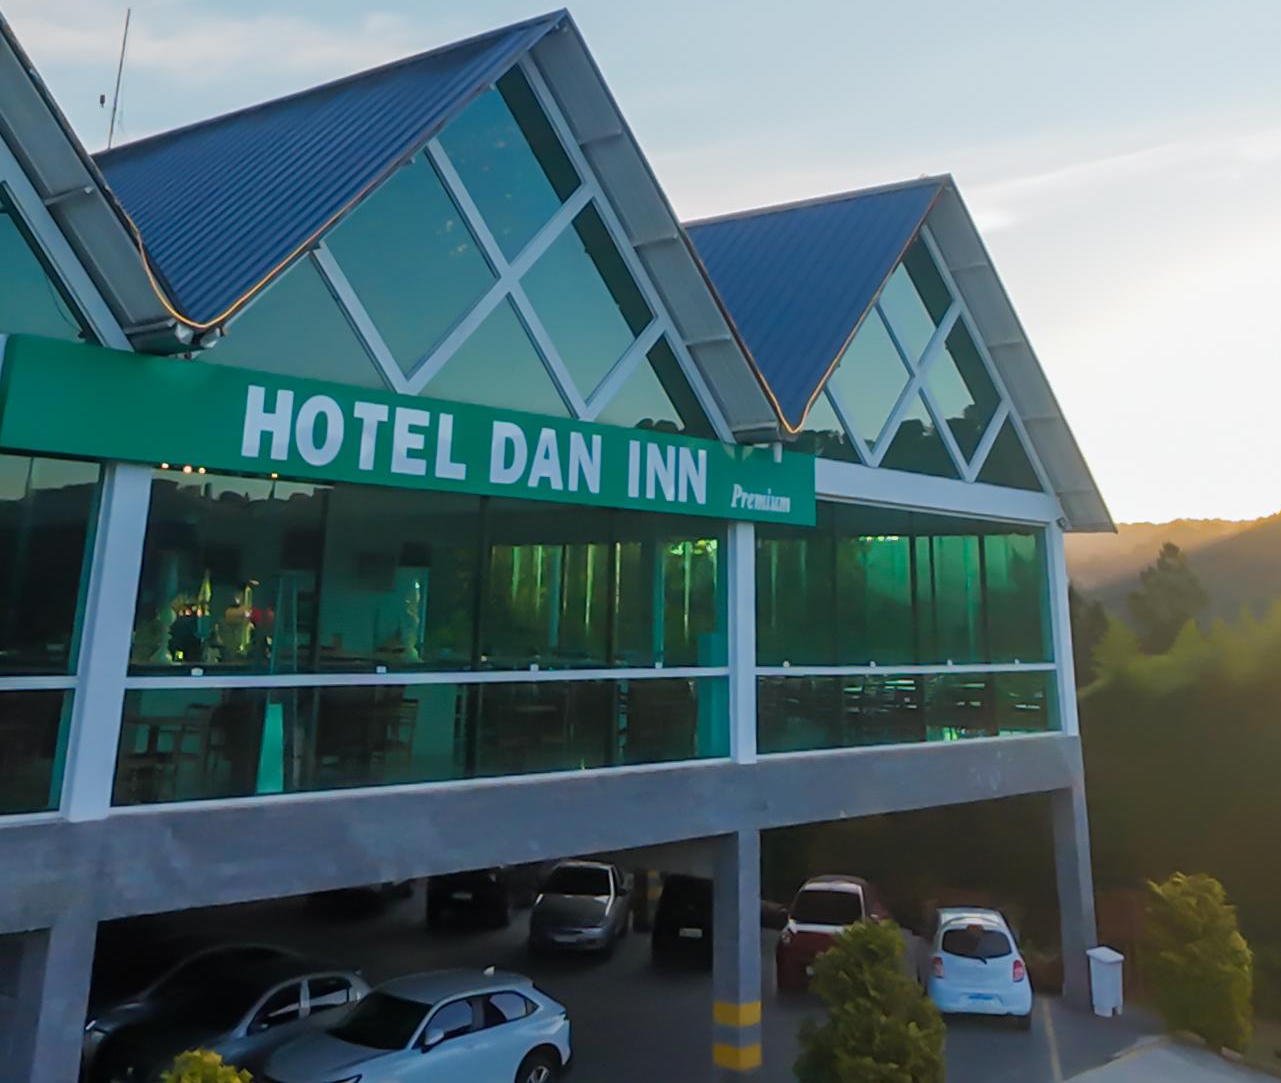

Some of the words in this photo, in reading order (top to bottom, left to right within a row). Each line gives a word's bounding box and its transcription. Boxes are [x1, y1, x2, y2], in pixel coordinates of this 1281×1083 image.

[241, 385, 466, 481] HOTEL
[490, 421, 601, 493] DAN
[627, 440, 707, 505] INN
[730, 483, 790, 513] Premium
